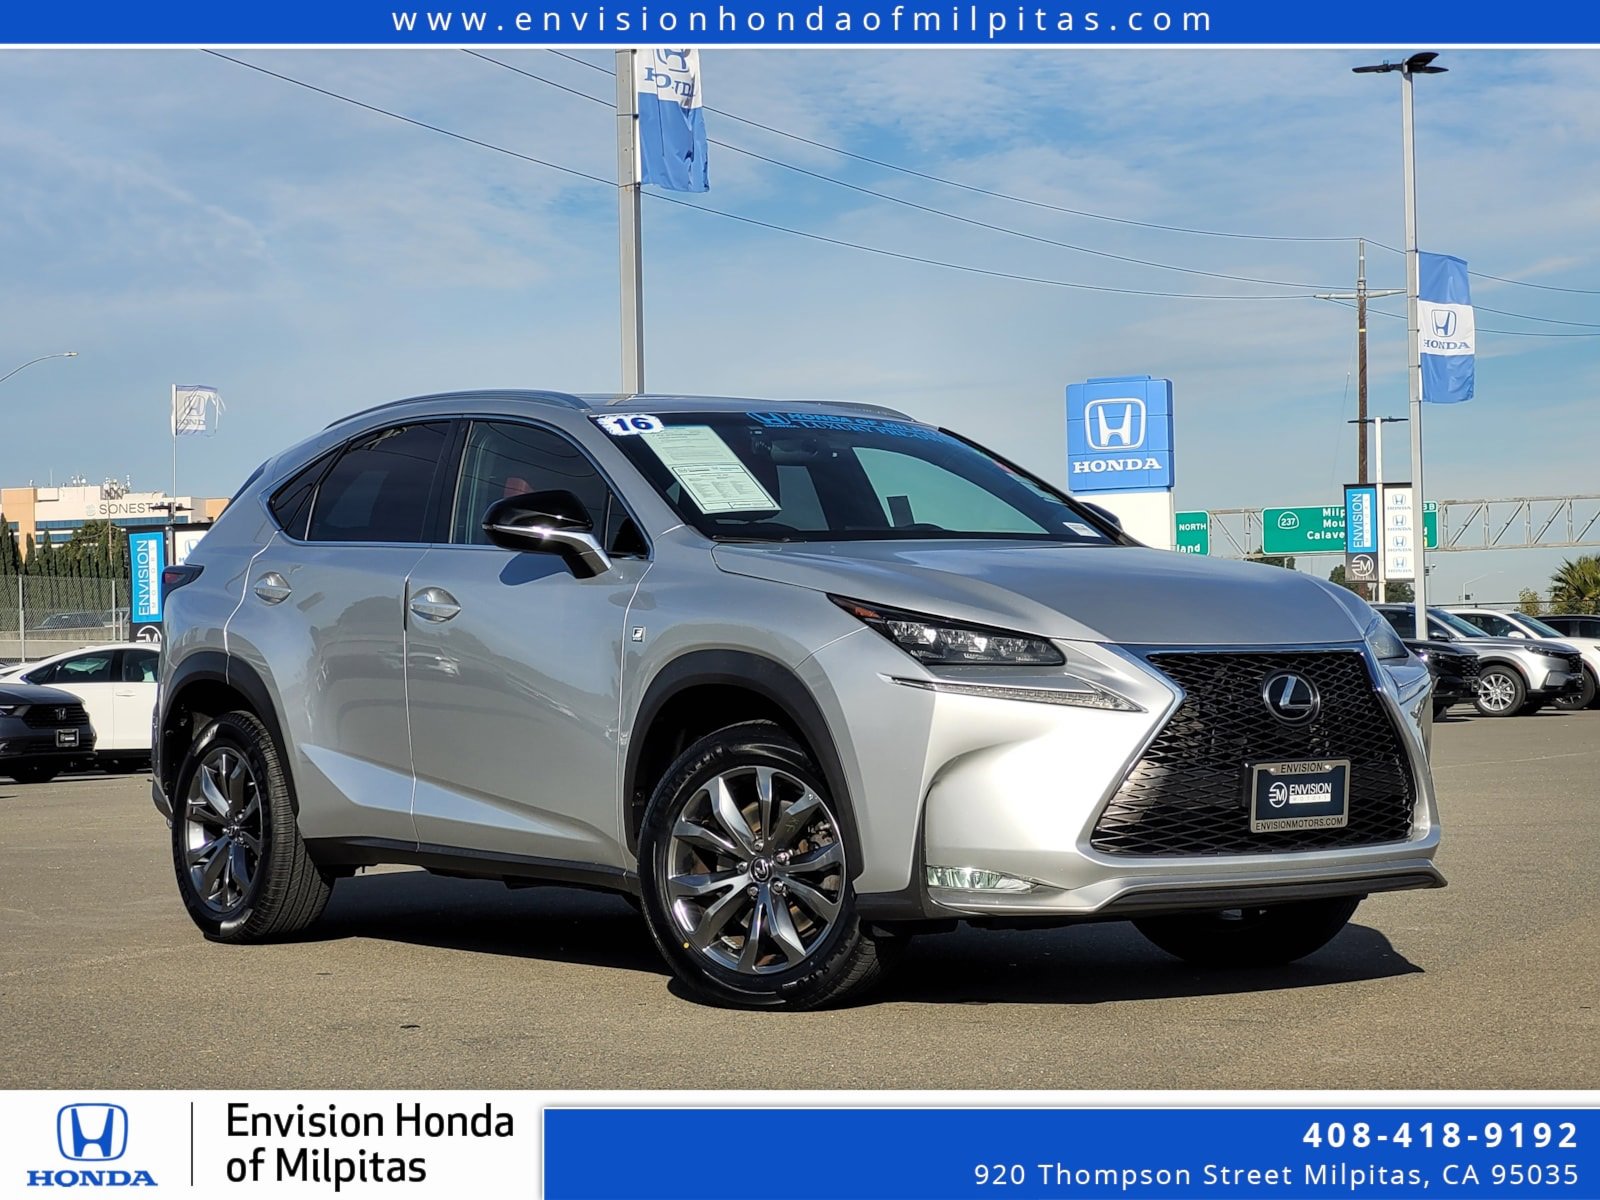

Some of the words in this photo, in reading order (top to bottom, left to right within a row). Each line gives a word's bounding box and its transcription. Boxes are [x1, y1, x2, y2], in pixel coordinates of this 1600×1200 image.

[1424, 339, 1470, 350] HONDA
[613, 417, 654, 431] 16
[1073, 457, 1162, 474] HONDA
[99, 502, 162, 515] SONESTA
[1179, 523, 1206, 531] NORTH
[1281, 517, 1296, 527] 237
[1323, 519, 1345, 528] Mou
[1352, 493, 1364, 548] ENVISION
[1307, 531, 1345, 540] Calave
[136, 540, 150, 616] ENVISION
[1281, 762, 1323, 774] ENVISION
[1289, 782, 1332, 795] ENVISION
[1255, 817, 1343, 831] ENVISIONMOTORS.COM
